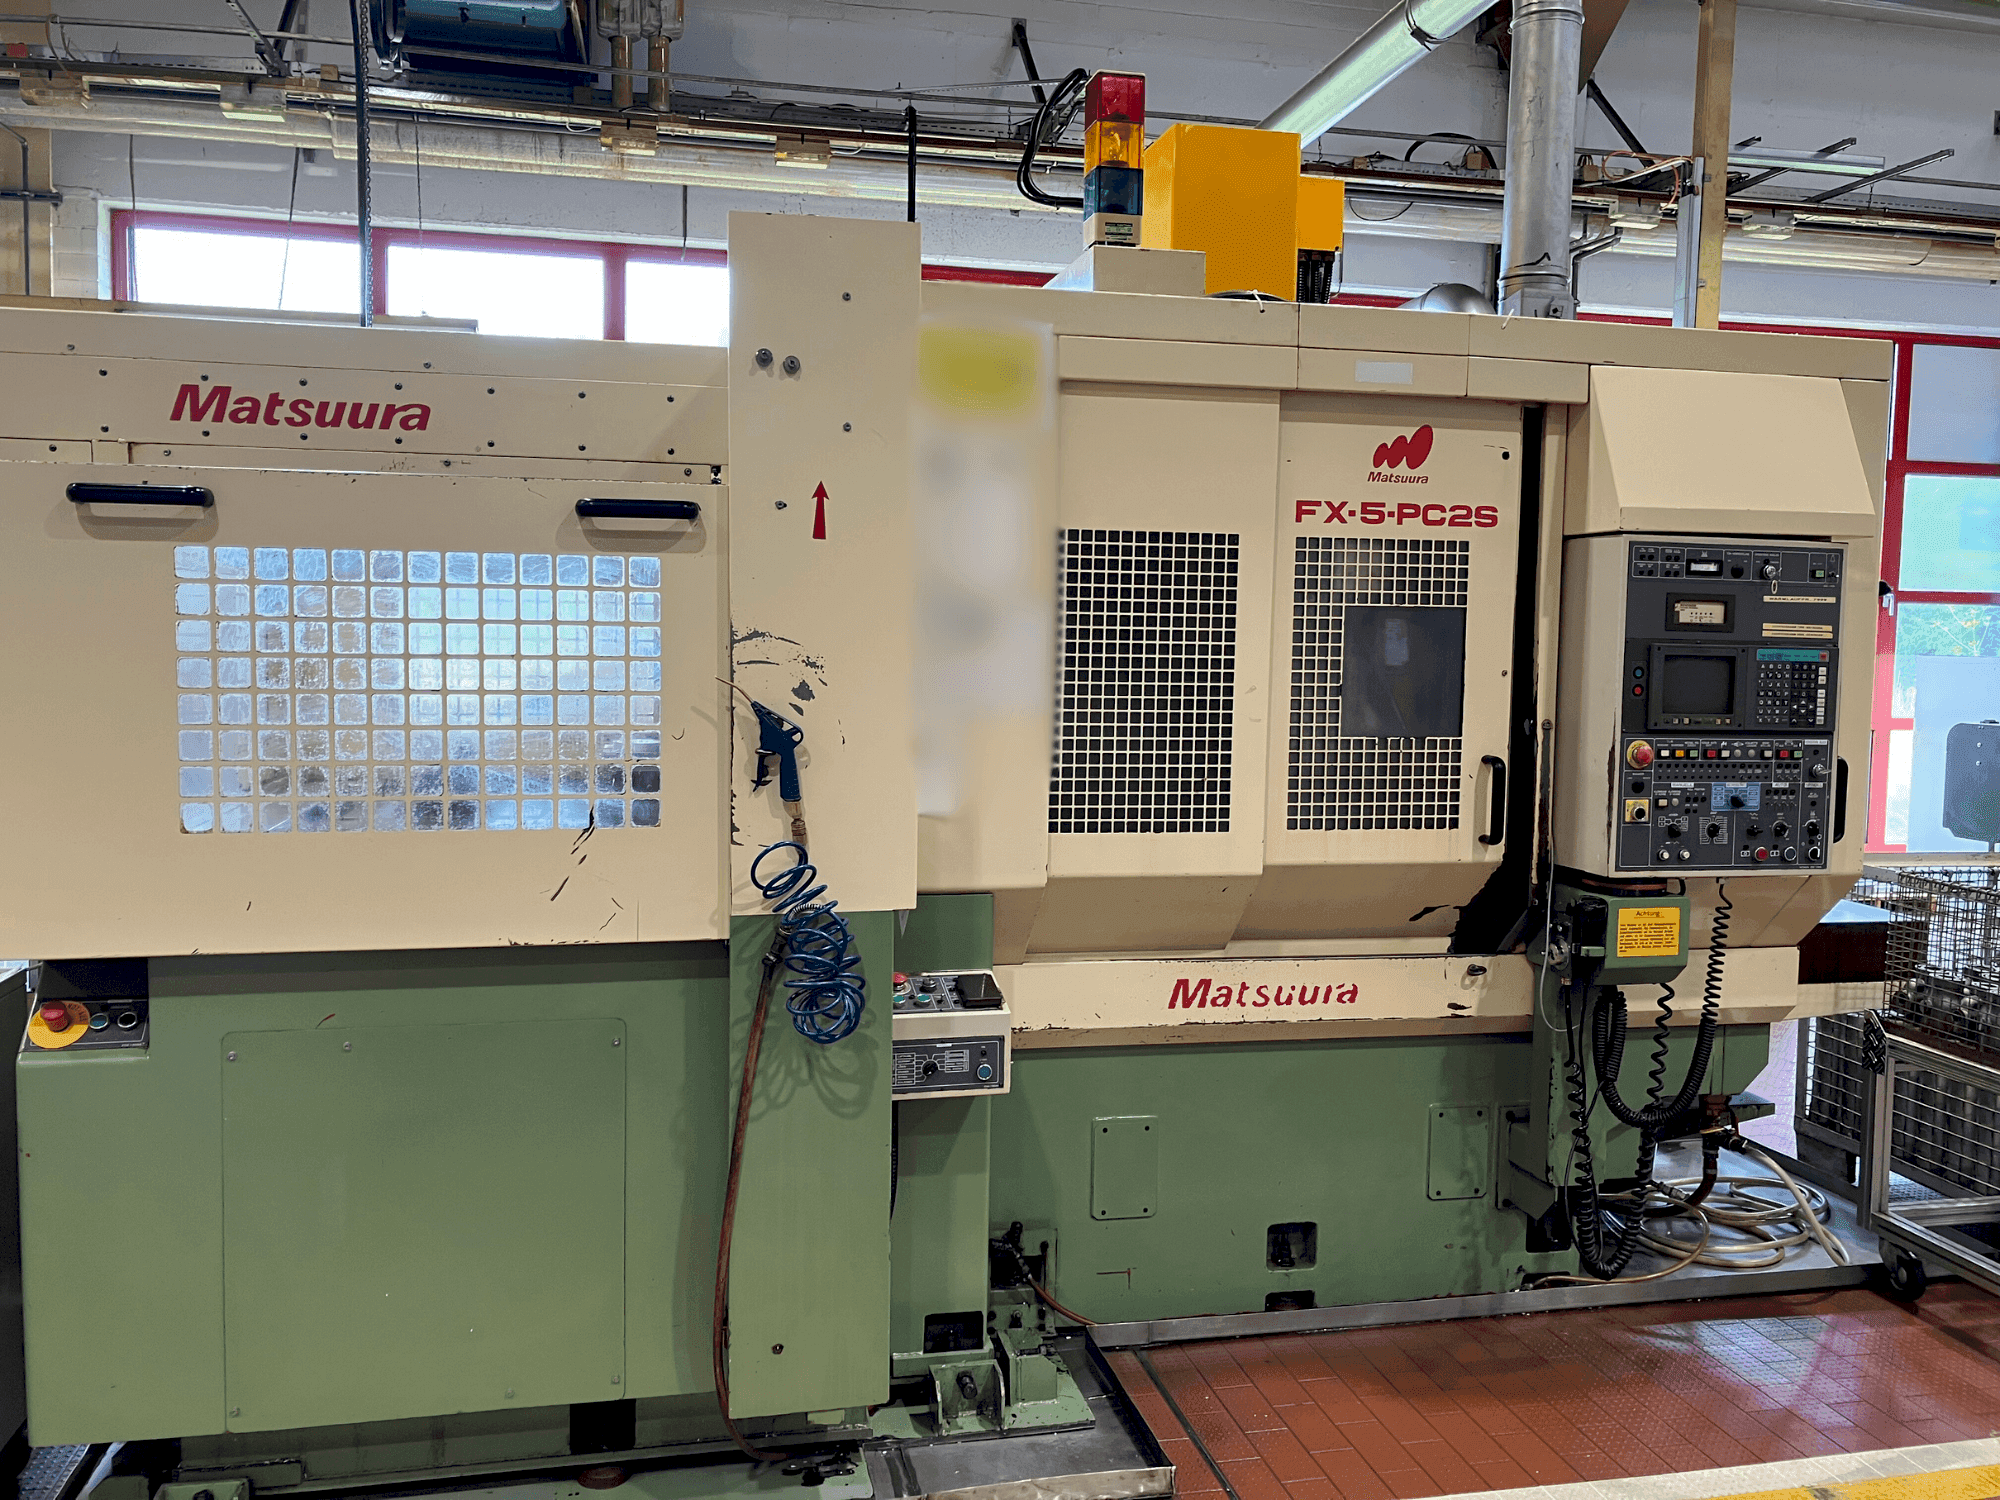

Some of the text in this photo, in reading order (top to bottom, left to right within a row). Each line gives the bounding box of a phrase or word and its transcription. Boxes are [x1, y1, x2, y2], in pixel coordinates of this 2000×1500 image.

[169, 383, 431, 431] Matsuura
[1367, 471, 1429, 484] Matsuura
[1167, 978, 1359, 1009] Matsuura
